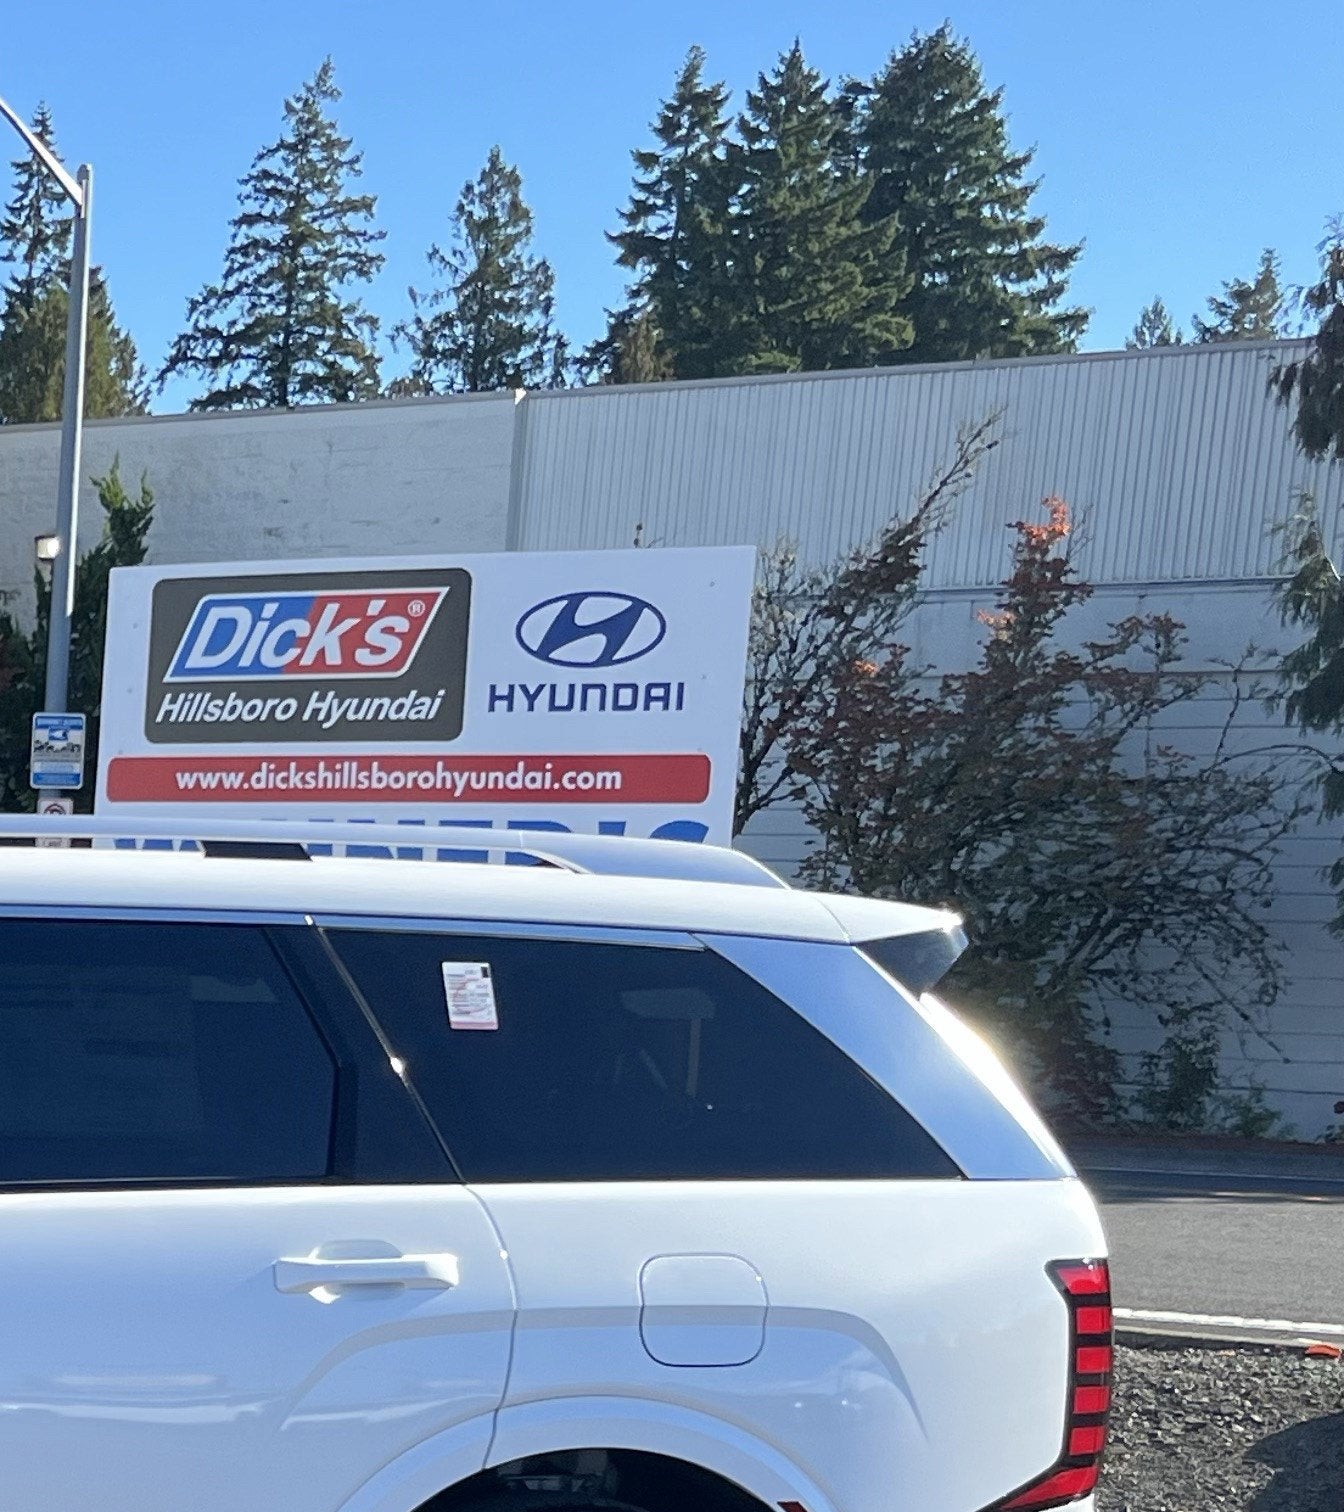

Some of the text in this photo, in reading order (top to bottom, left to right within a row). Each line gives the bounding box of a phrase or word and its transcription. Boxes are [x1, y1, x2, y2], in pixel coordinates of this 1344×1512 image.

[155, 689, 446, 729] Hillsboro Hyundai
[487, 682, 685, 713] HYUNDAI
[175, 761, 622, 798] www.dickshillsborohyundai.com
